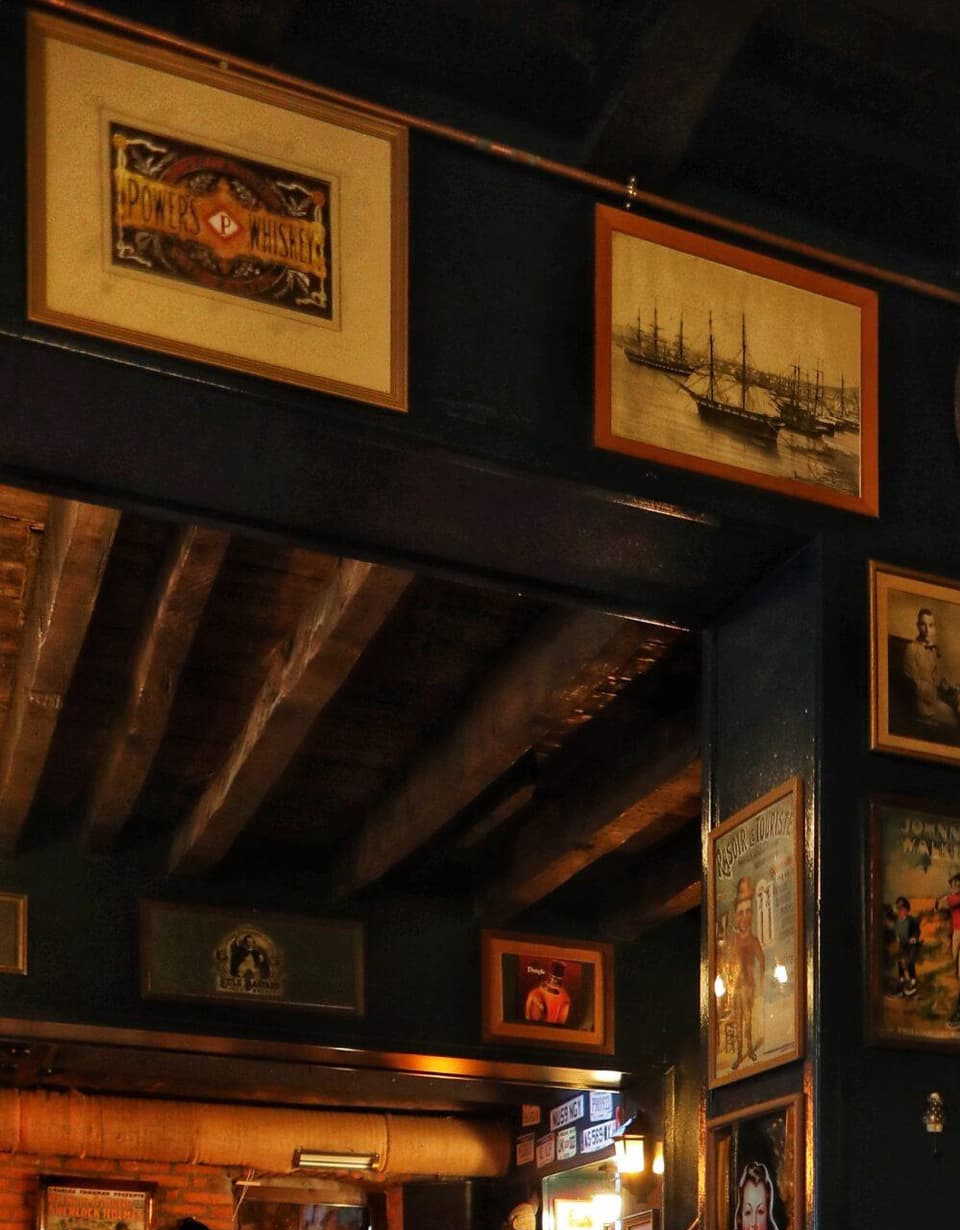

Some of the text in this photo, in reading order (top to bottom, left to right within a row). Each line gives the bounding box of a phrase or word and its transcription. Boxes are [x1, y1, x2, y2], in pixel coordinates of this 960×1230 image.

[126, 179, 316, 265] POWERS P WHISKEY
[717, 828, 749, 880] RASOIR
